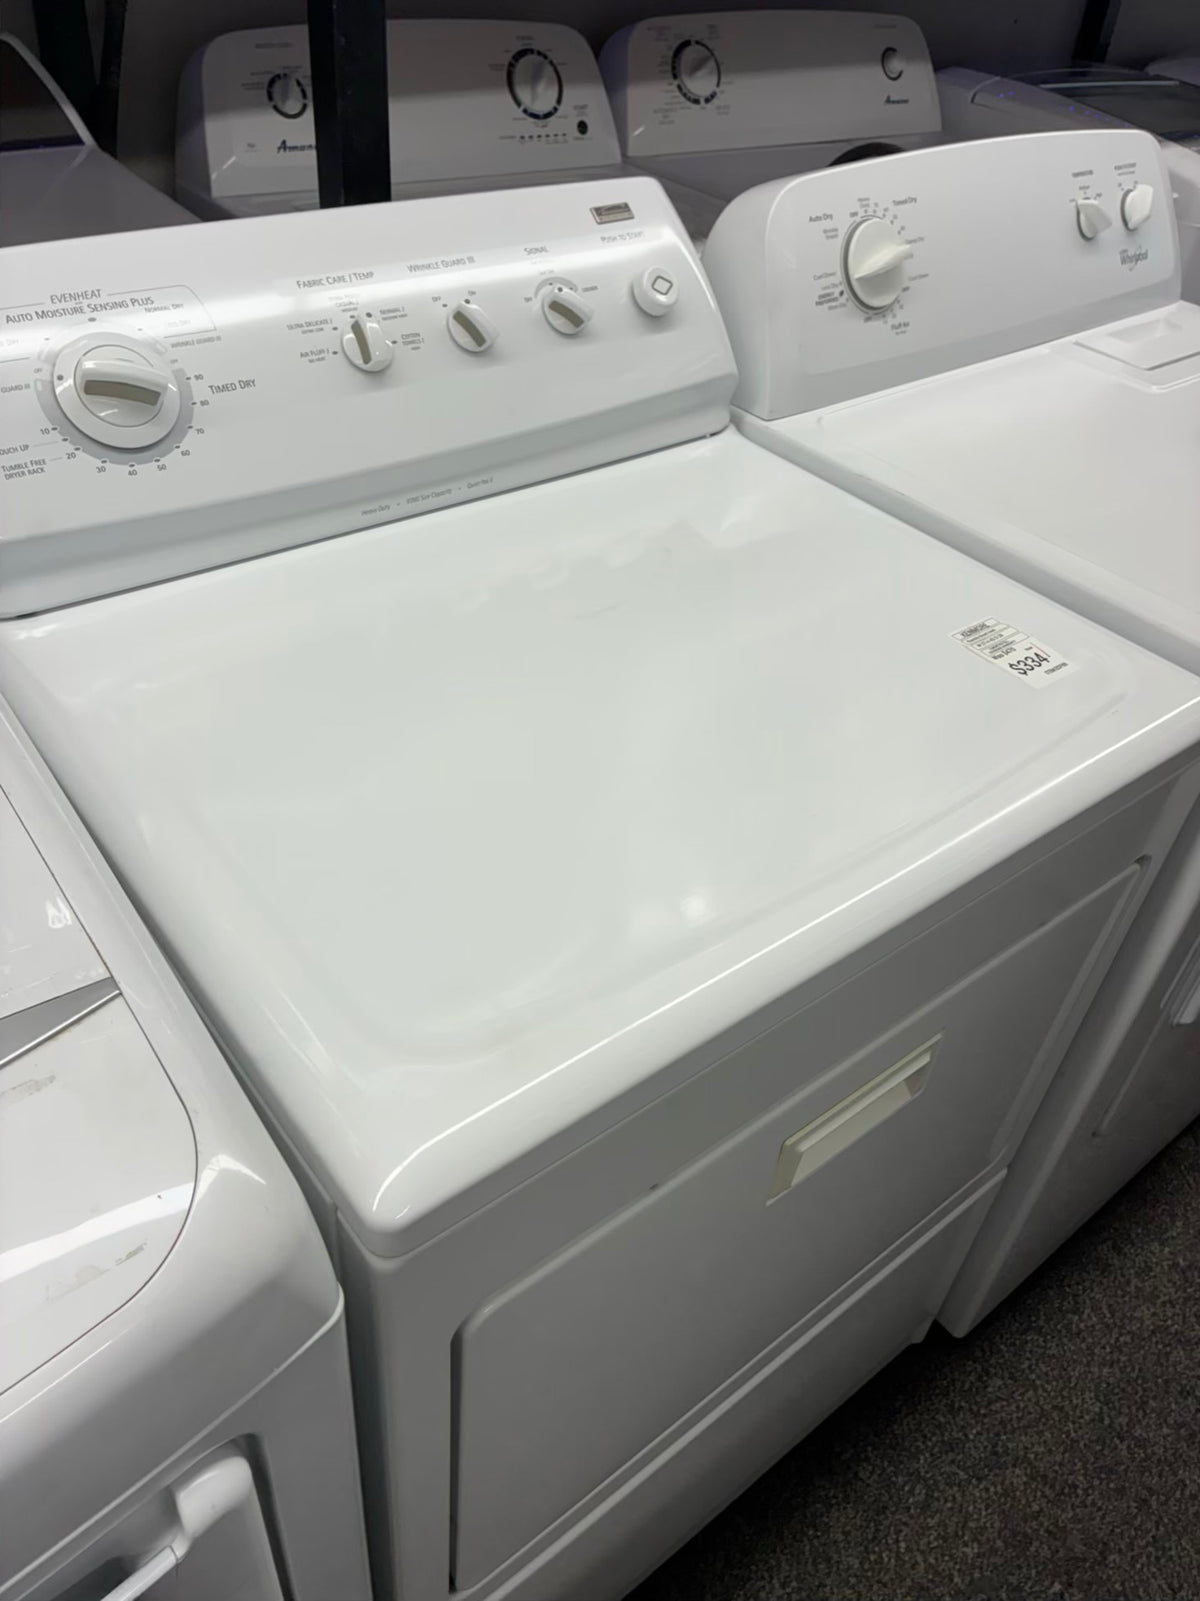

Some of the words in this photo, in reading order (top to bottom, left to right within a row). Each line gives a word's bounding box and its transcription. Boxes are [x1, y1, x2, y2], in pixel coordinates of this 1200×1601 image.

[277, 139, 318, 154] Aman
[907, 196, 918, 204] Dry
[523, 245, 549, 255] SIGNAL
[406, 261, 441, 272] WRINKLE
[441, 257, 466, 269] GUARD
[296, 277, 325, 290] FABRIC
[326, 274, 348, 285] CARE
[353, 271, 375, 282] TEMP
[50, 288, 102, 304] EVENHEAT
[5, 313, 33, 324] AUTO
[35, 304, 87, 321] MOISTURE
[87, 299, 129, 313] SENSING
[130, 296, 155, 307] PLUS
[193, 373, 204, 381] 90
[0, 384, 23, 393] GUARD
[208, 383, 237, 395] TIMED
[238, 379, 257, 390] DRY
[200, 399, 210, 407] 80
[40, 427, 50, 435] 10
[195, 427, 205, 435] 70
[19, 443, 29, 452] UP
[65, 451, 77, 460] 20
[181, 449, 191, 457] 60
[1, 462, 29, 473] TUMBLE
[30, 458, 47, 468] FREE
[96, 466, 106, 474] 30
[157, 464, 167, 472] 50
[4, 470, 27, 481] DRYER
[27, 466, 46, 476] RACK
[128, 469, 138, 477] 40
[1008, 652, 1051, 676] $334
